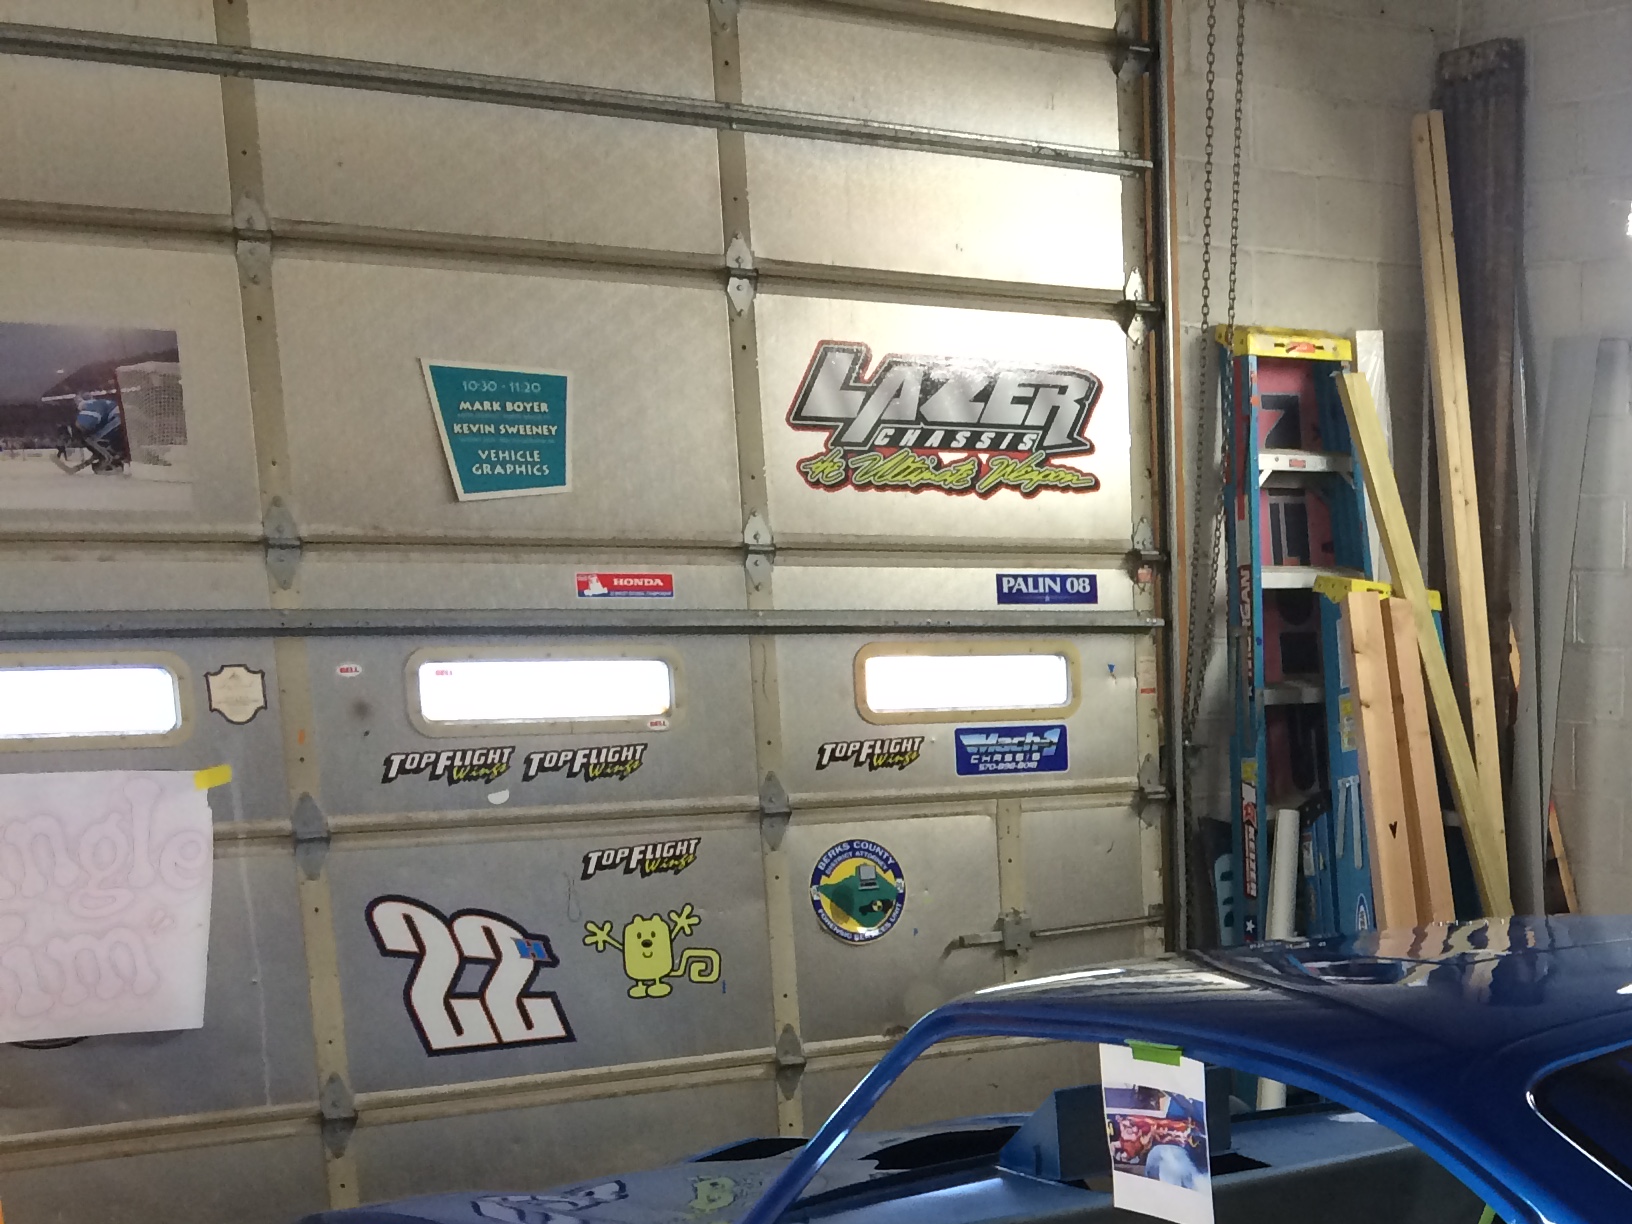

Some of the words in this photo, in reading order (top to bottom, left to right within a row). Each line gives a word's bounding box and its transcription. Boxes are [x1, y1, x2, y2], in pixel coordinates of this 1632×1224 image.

[462, 380, 498, 392] 10:30
[459, 400, 501, 412] MARK
[505, 401, 549, 413] BOYER
[799, 348, 1092, 448] LAZER
[453, 423, 495, 434] KEVIN
[499, 424, 558, 435] SWEENEY
[873, 427, 1040, 450] CHASSIS
[478, 449, 541, 462] VEHICLE
[471, 463, 550, 476] GRAPHICS
[612, 577, 664, 587] HONDA
[1001, 576, 1061, 594] PALIN
[1065, 577, 1092, 594] 08
[818, 841, 851, 871] BERKS
[853, 840, 895, 865] COUNTY
[855, 850, 888, 871] ATTORNEY
[817, 908, 853, 940] FORENSIC
[365, 895, 577, 1058] 22
